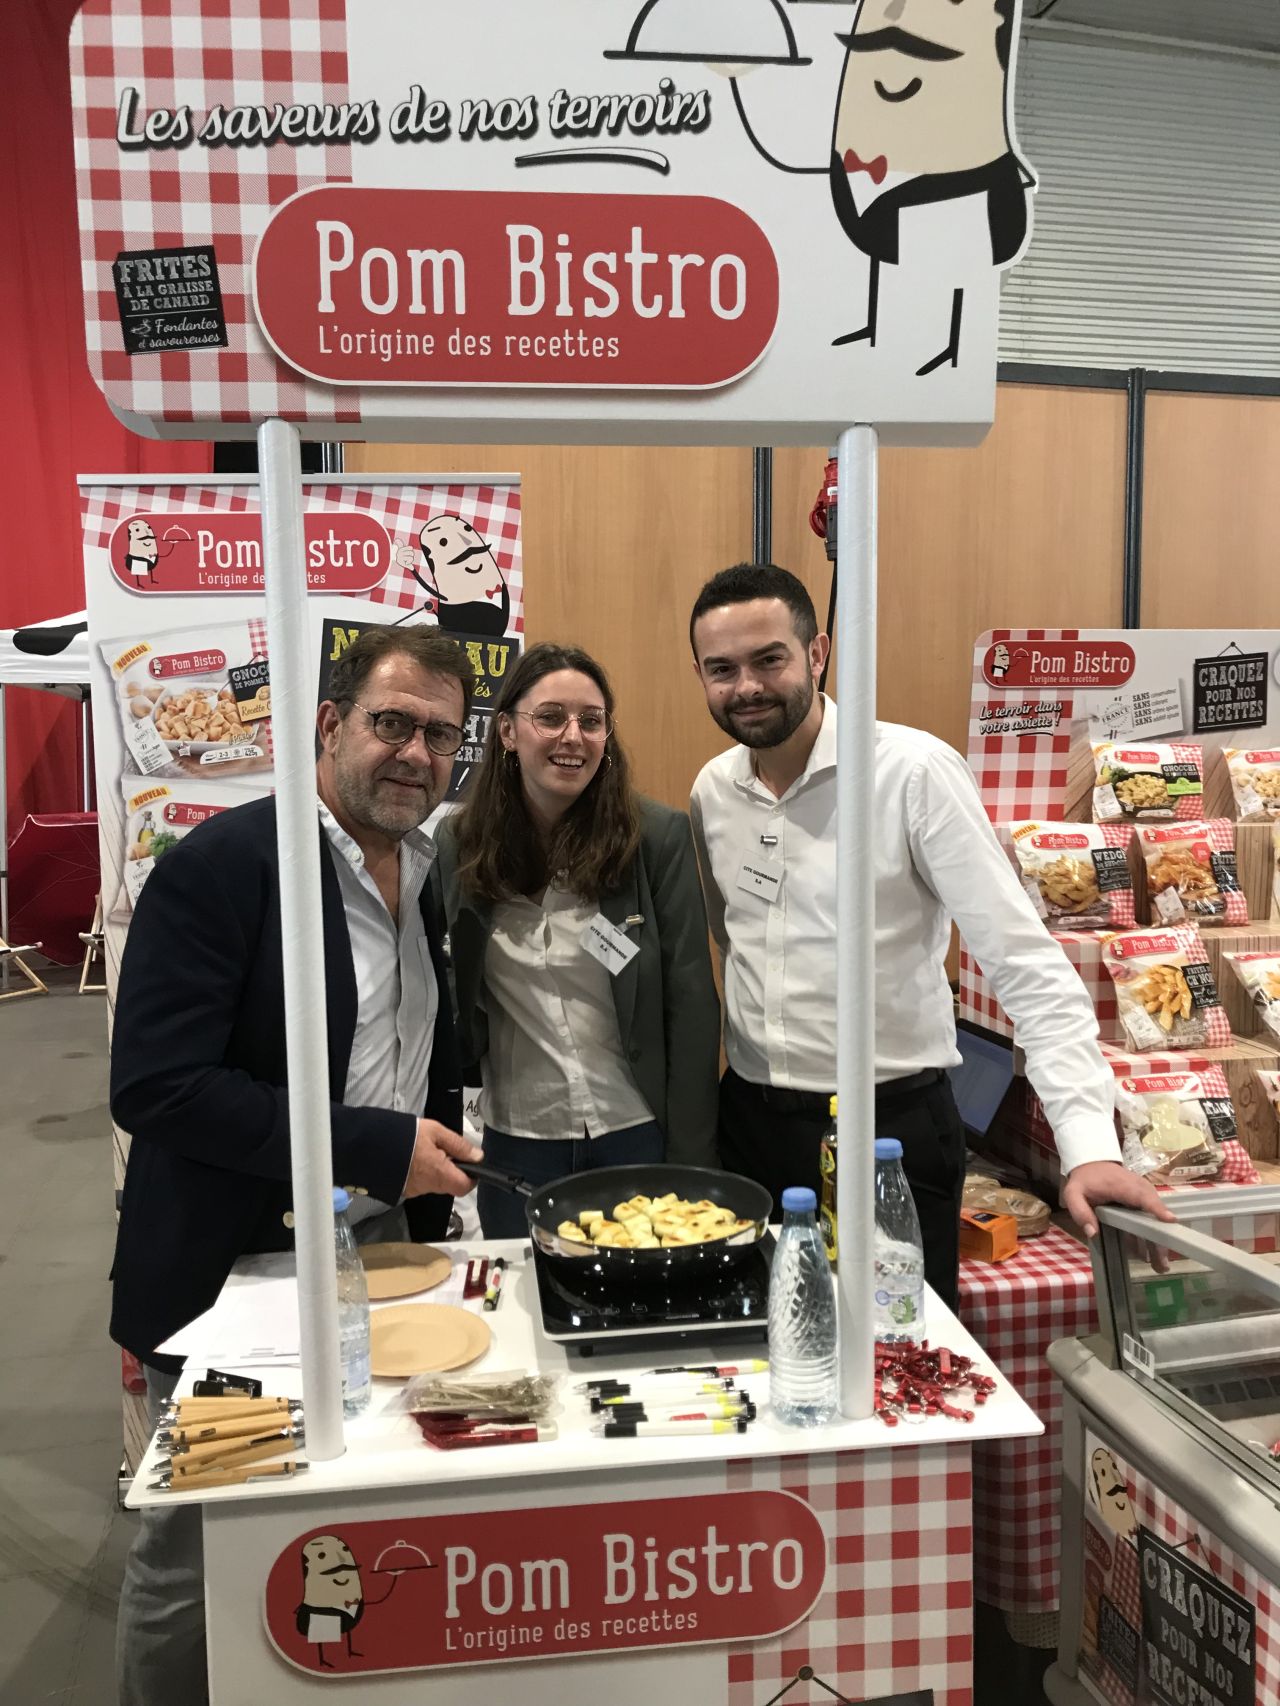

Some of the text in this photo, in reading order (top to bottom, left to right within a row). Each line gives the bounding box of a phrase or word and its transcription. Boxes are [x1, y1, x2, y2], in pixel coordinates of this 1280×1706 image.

[116, 78, 712, 149] Les saveurs de nos terroirs
[118, 254, 211, 283] FRITES
[316, 220, 747, 321] Pom Bistro
[136, 284, 154, 297] LA
[158, 280, 214, 295] GRAISSE
[130, 294, 210, 311] DE CANARD
[155, 316, 218, 334] Fondantes
[149, 332, 221, 348] savoureuses
[319, 325, 621, 361] L'origine des recettes
[197, 530, 261, 568] Pom
[198, 572, 265, 587] L'origine de
[116, 644, 149, 670] NOUVEAU
[172, 655, 224, 671] Pom Bistro
[1031, 650, 1130, 673] Pom Bistro
[1199, 662, 1264, 688] CRAQUEZ
[1132, 692, 1150, 702] SANS
[1206, 686, 1256, 703] POUR NOS
[979, 701, 1063, 720] Le terroir dans
[1133, 700, 1151, 710] SANS
[1134, 708, 1152, 718] SANS
[1199, 700, 1263, 723] RECETTES
[979, 721, 1010, 734] votre
[1012, 716, 1053, 731] assiette
[1135, 716, 1153, 726] SANS
[133, 787, 167, 807] NOUVEAU
[187, 808, 206, 820] Pom
[445, 1525, 804, 1618] Pom Bistro
[1143, 1548, 1250, 1665] CRAQUEZ
[446, 1610, 698, 1652] L'origine des recettes
[1160, 1615, 1197, 1668] POUR
[1205, 1651, 1233, 1697] NOS
